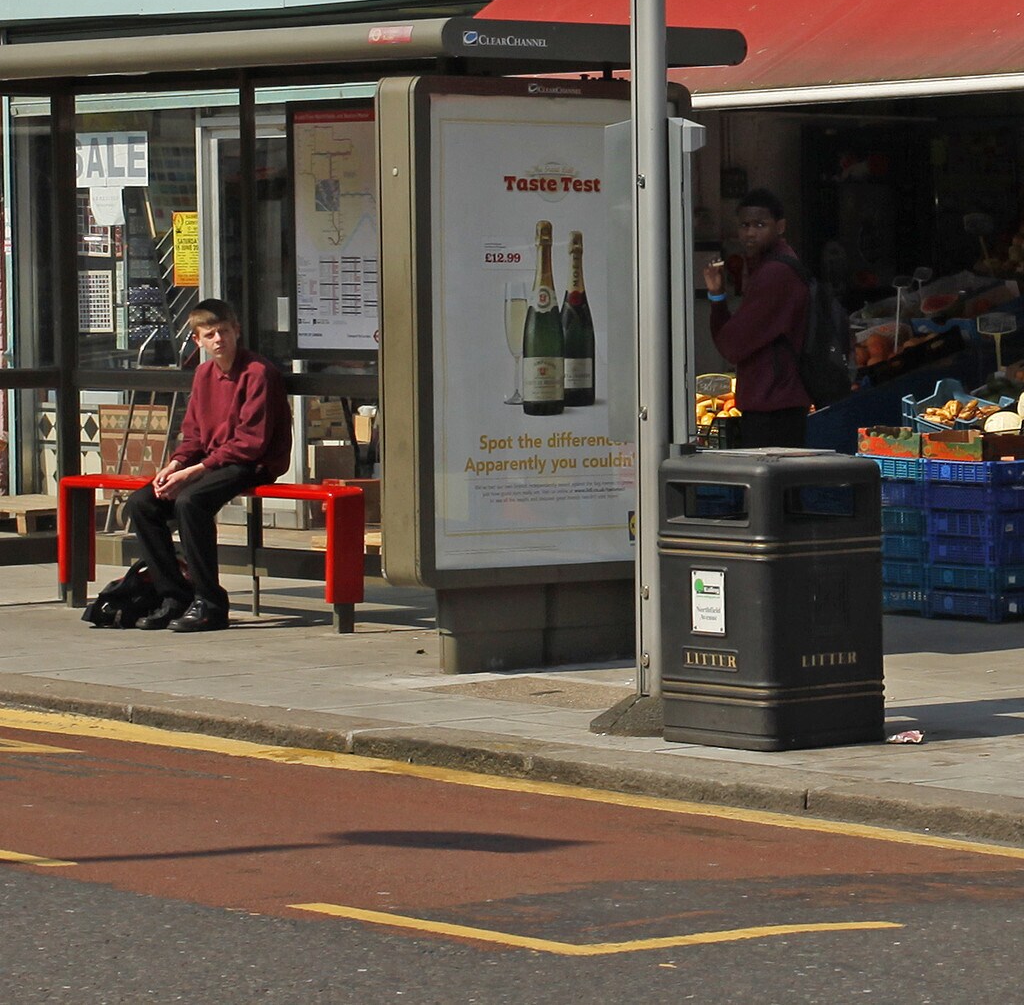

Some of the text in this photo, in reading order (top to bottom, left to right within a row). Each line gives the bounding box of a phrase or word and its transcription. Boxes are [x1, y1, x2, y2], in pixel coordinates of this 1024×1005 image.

[503, 175, 602, 193] Taste Test
[484, 252, 521, 263] £12.99
[479, 434, 513, 454] Spot
[517, 433, 543, 449] the
[464, 454, 547, 475] Apparently
[551, 457, 577, 474] you
[696, 605, 721, 614] Northfield
[686, 651, 737, 668] LITTER
[802, 651, 857, 668] LITTER
